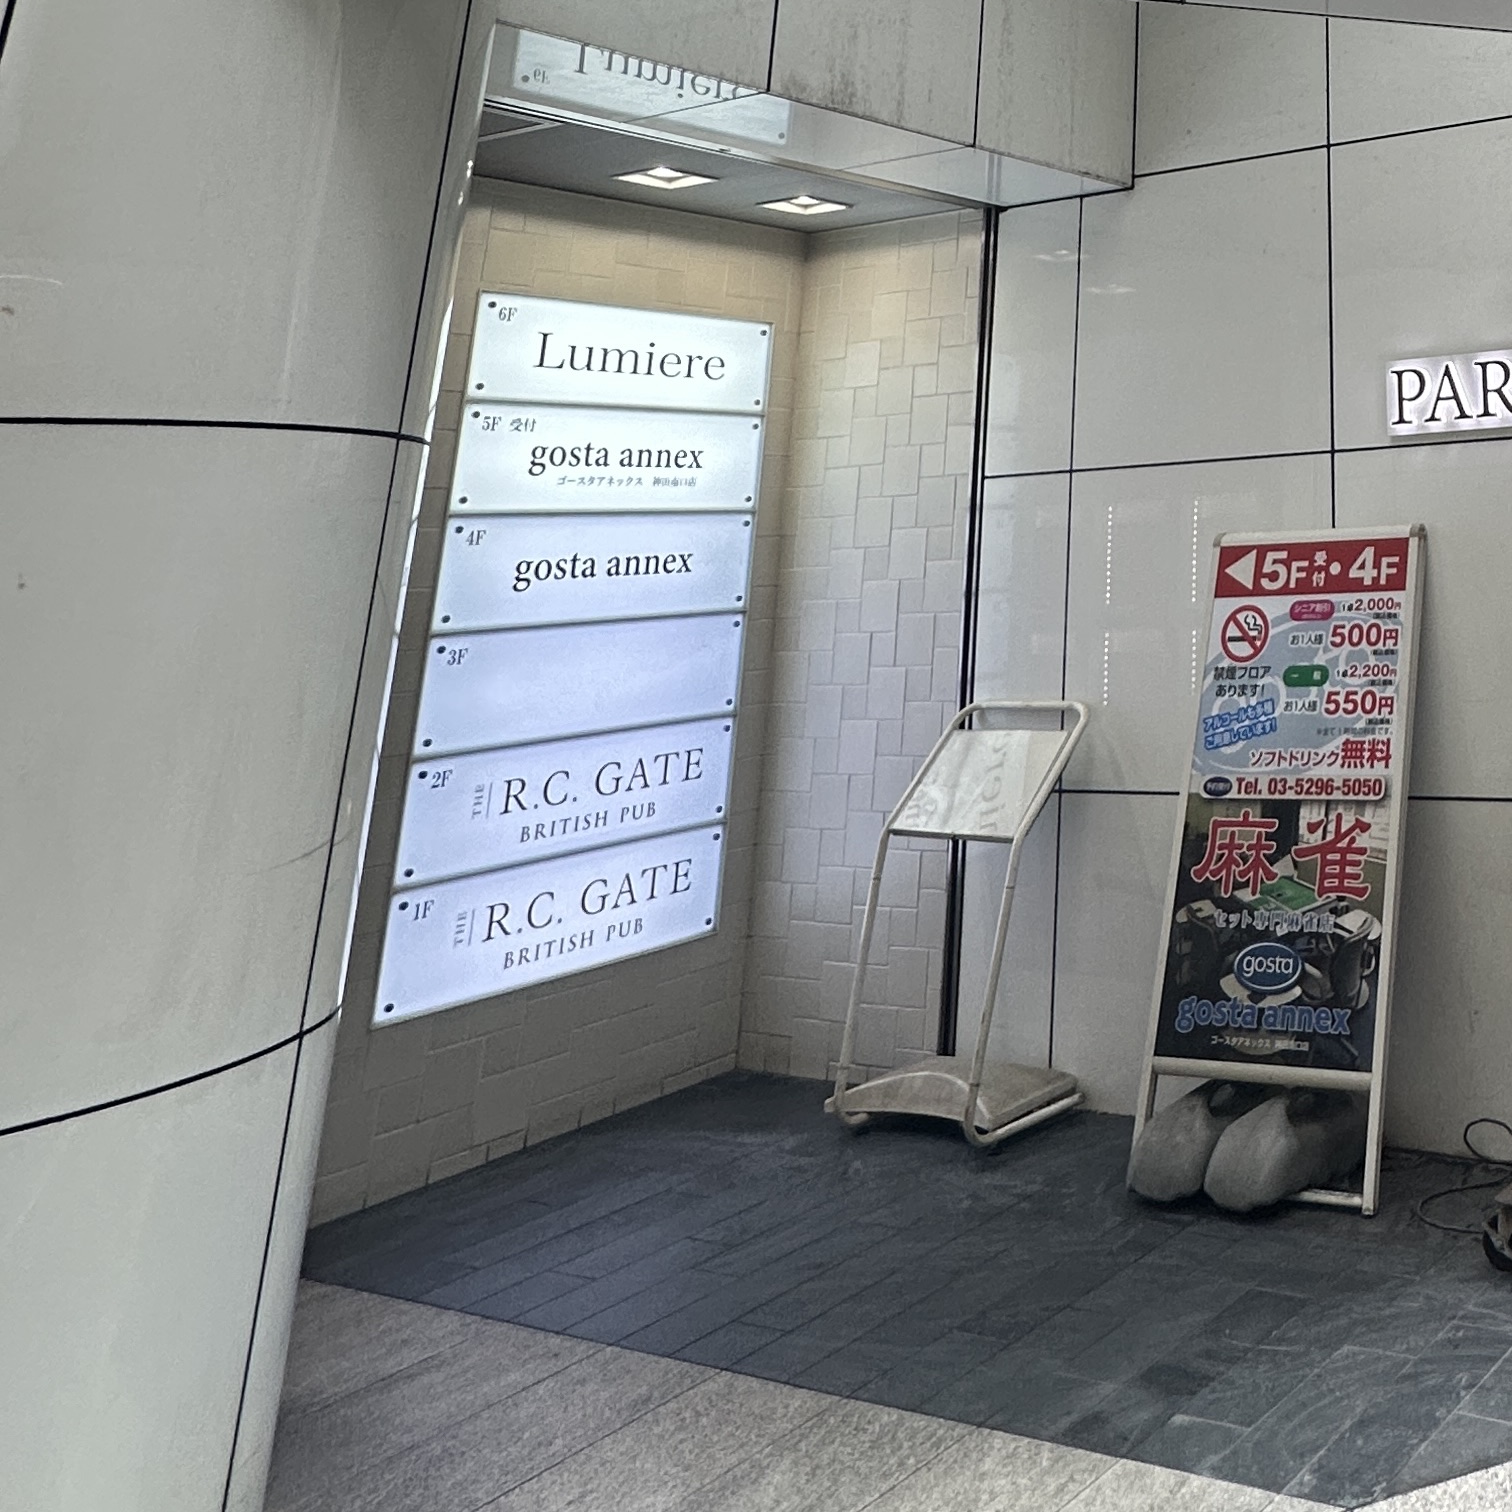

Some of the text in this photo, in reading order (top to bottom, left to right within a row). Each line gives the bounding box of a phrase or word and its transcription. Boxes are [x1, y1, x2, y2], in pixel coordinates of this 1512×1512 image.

[498, 306, 518, 322] 6F
[532, 331, 727, 381] Lumiere
[481, 415, 537, 434] 5F 受付
[528, 441, 704, 476] gosta annex
[465, 529, 487, 547] 4F
[512, 550, 694, 592] gosta annex
[1329, 622, 1399, 648] 500円
[447, 648, 469, 666] 3F
[1213, 665, 1272, 681] 禁煙フロア
[1324, 689, 1395, 716] 550円
[430, 768, 453, 789] 2F
[499, 747, 704, 816] R.C. GATE
[1236, 777, 1263, 796] Tel.
[1267, 776, 1383, 797] 03-5296-5050
[519, 801, 657, 843] BRITISH PUB
[1190, 810, 1373, 901] 麻雀
[412, 899, 435, 922] 1F
[481, 858, 693, 943] R.C. GATE
[503, 917, 644, 971] BRITISH PUB
[1242, 954, 1293, 978] gosta
[1175, 995, 1352, 1035] gosta annex
